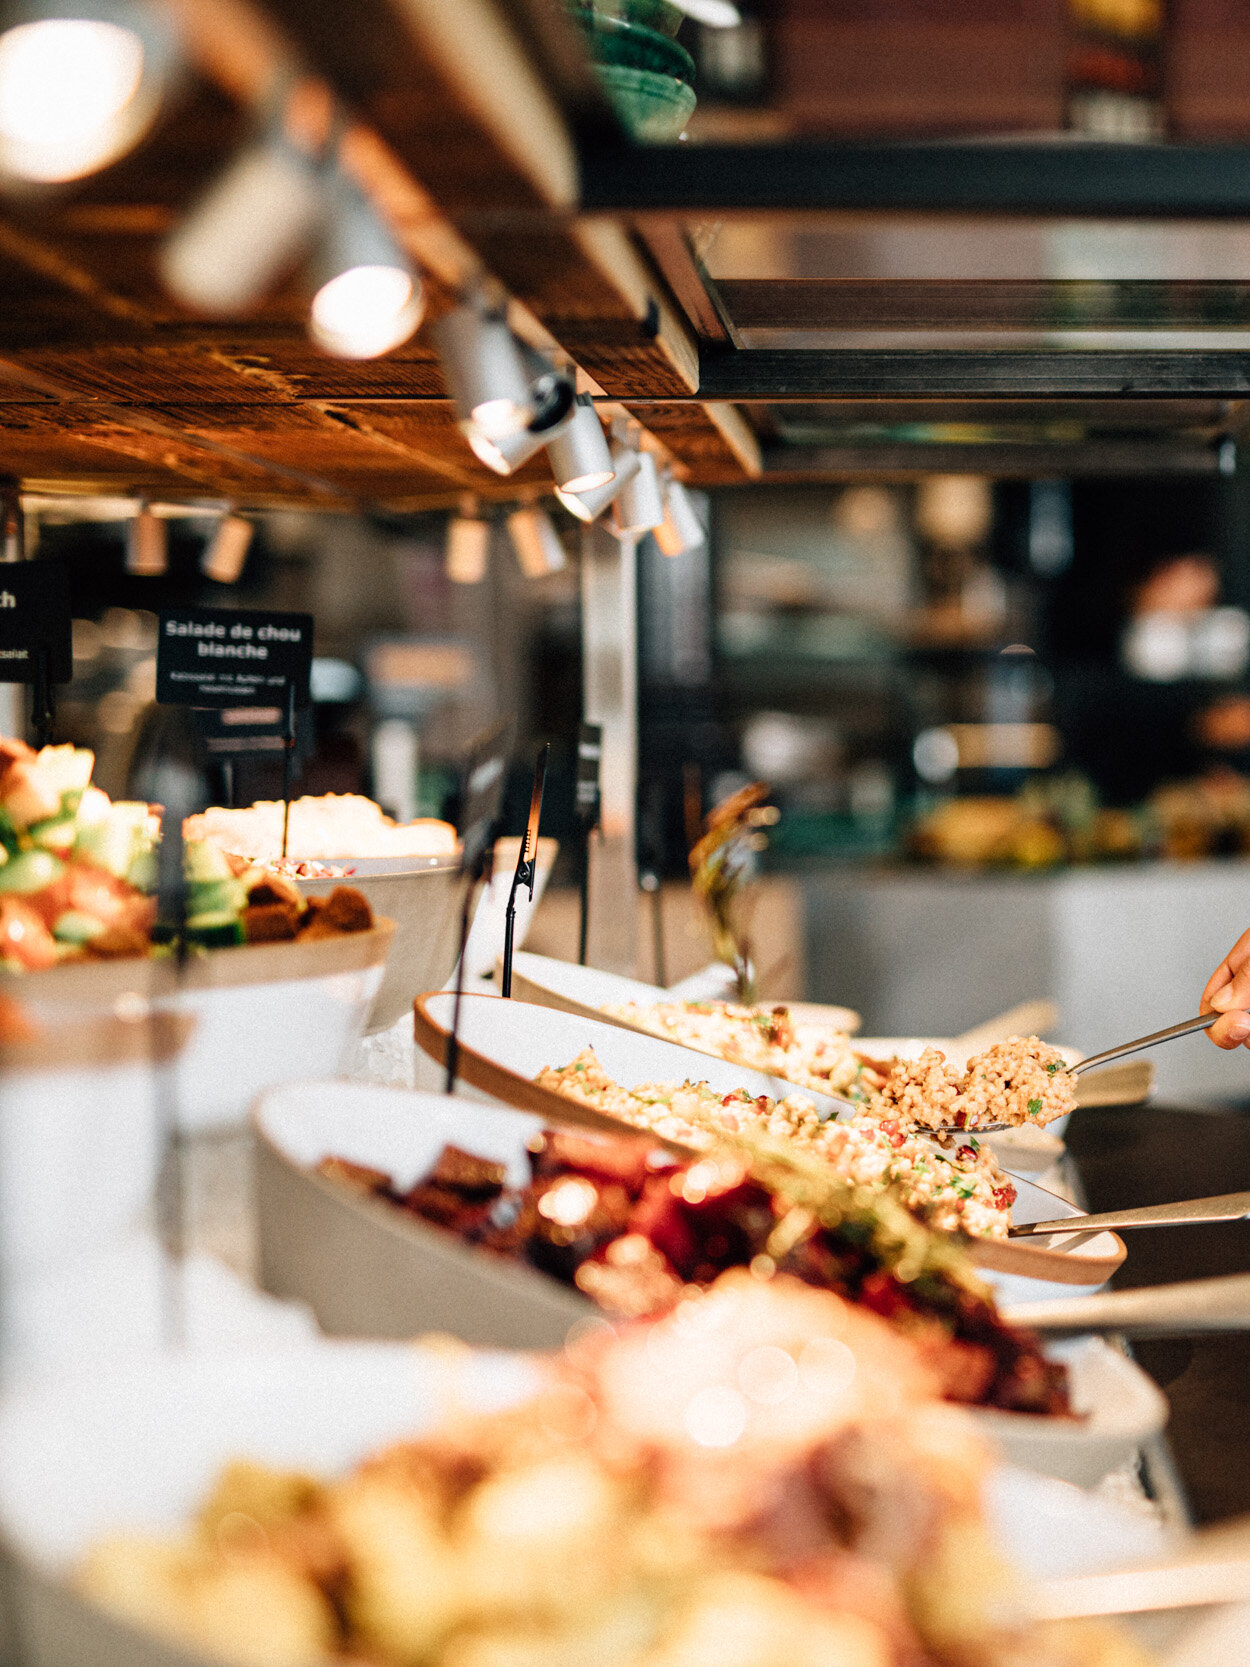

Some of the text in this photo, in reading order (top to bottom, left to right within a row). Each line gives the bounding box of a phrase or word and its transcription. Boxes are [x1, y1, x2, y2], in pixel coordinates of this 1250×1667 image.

[165, 620, 302, 642] Salade de chou
[197, 641, 269, 661] blanche
